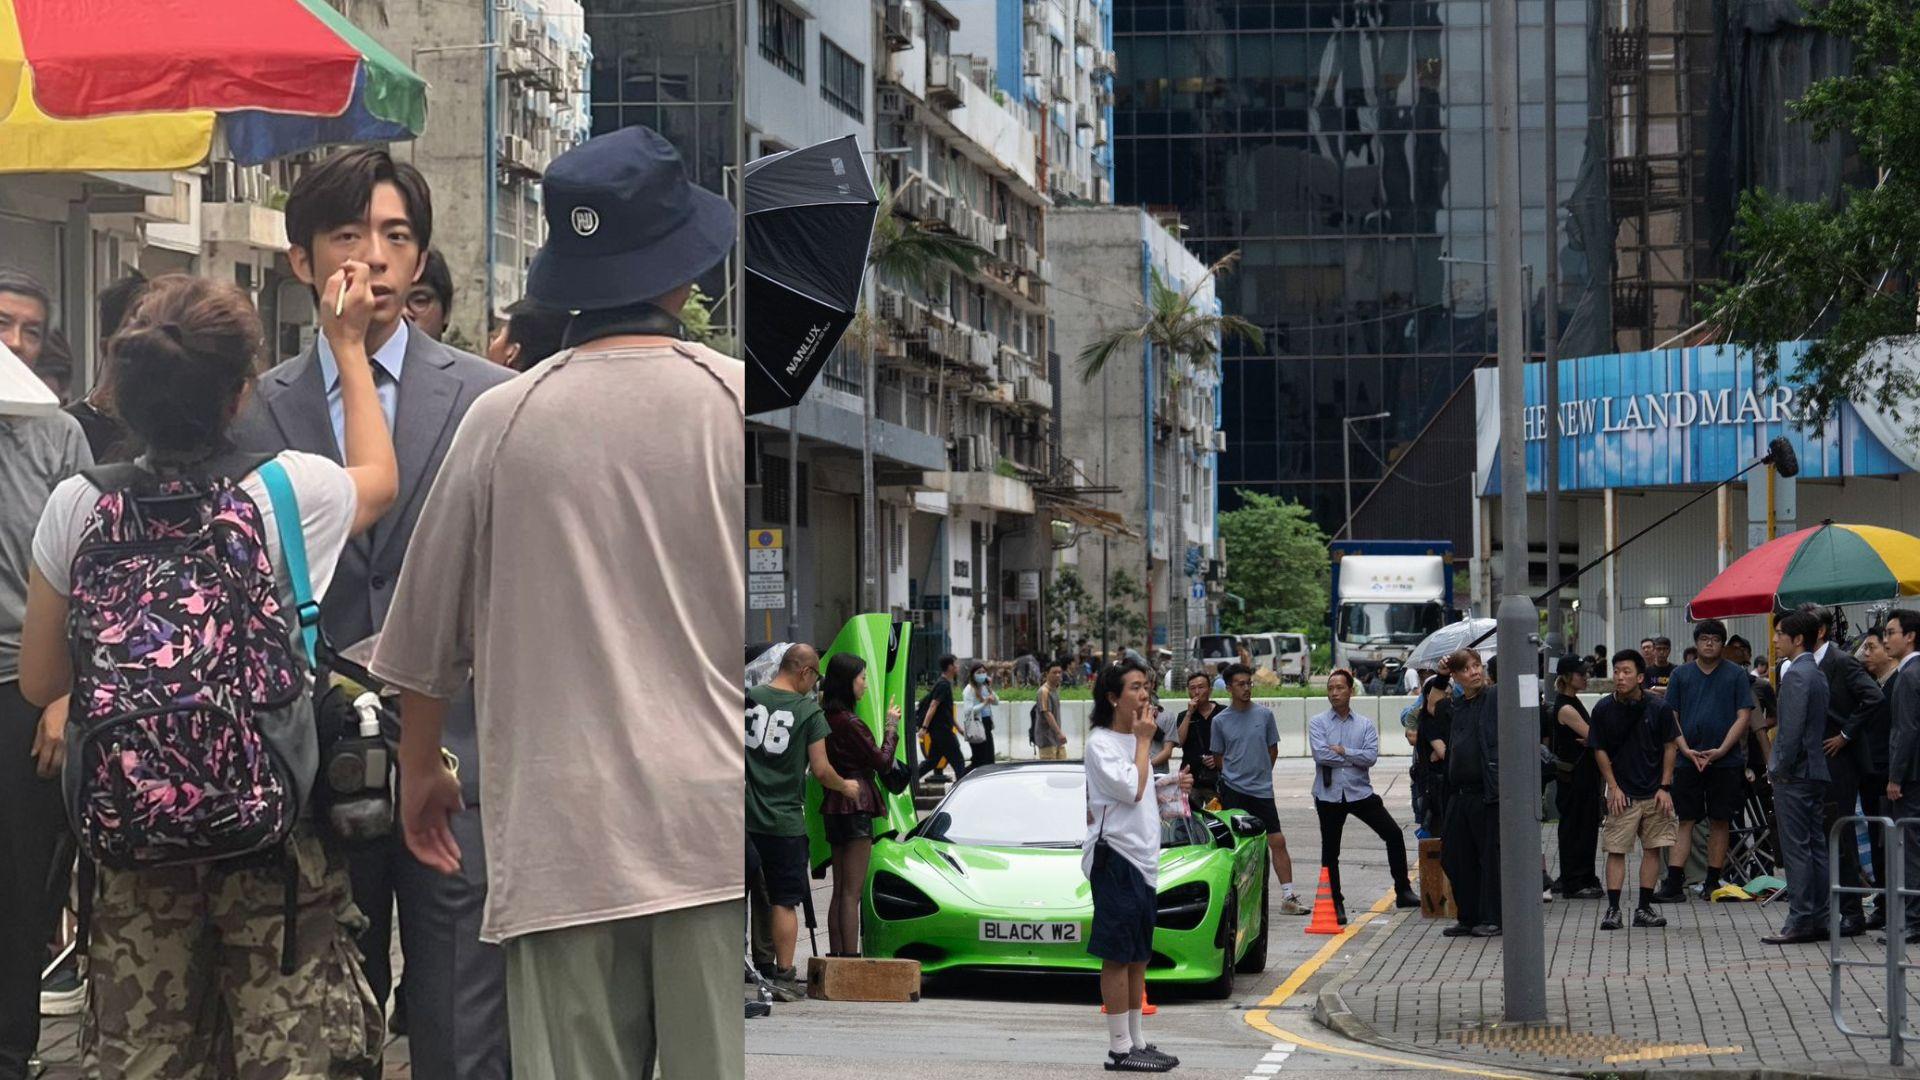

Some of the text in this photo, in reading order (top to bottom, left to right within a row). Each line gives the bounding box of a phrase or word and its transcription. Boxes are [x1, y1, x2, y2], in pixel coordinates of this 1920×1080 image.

[786, 323, 821, 376] NANLUX
[1523, 404, 1548, 442] HE
[1557, 397, 1597, 438] NEW
[745, 704, 795, 754] 36
[984, 922, 1076, 941] BLACK W2
